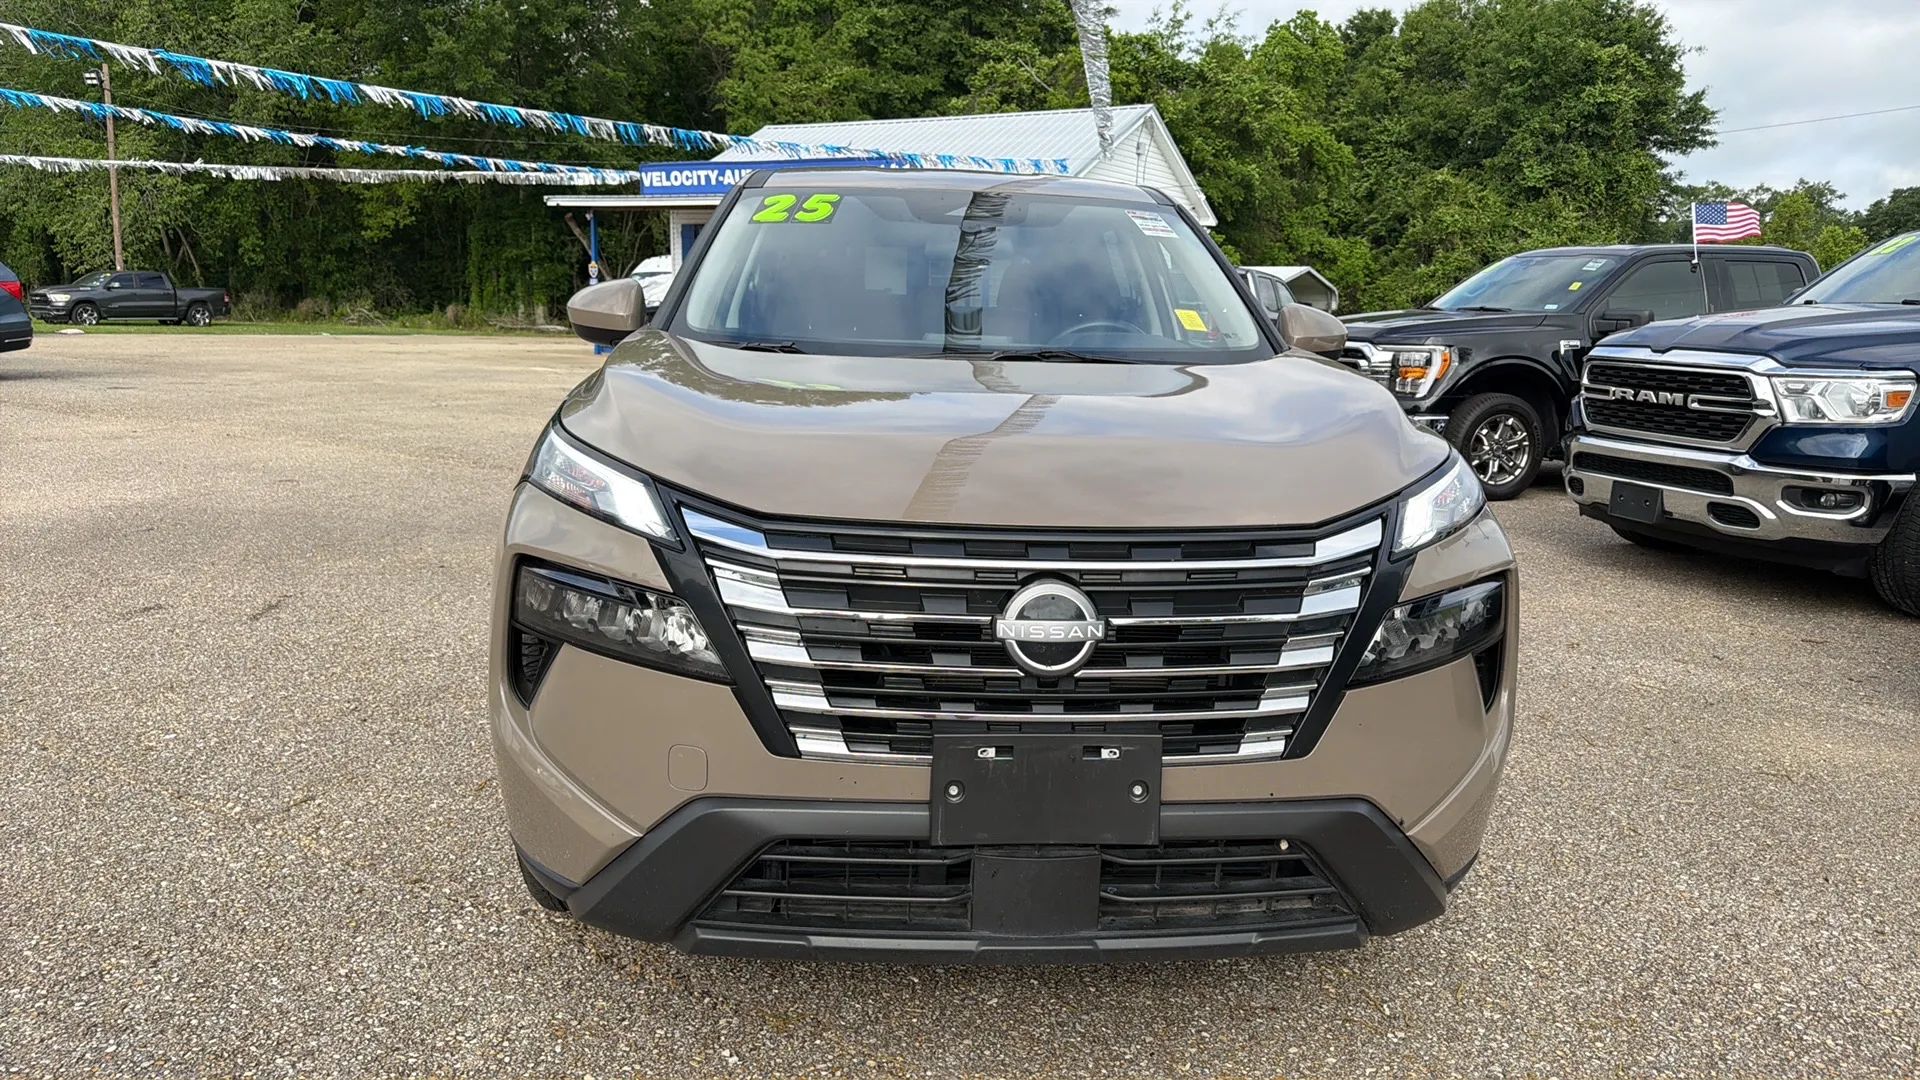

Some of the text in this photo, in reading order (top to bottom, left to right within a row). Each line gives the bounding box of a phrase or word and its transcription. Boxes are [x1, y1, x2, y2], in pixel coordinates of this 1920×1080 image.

[752, 194, 840, 222] 25
[1611, 386, 1684, 406] RAM
[1000, 624, 1103, 639] NISSAN
